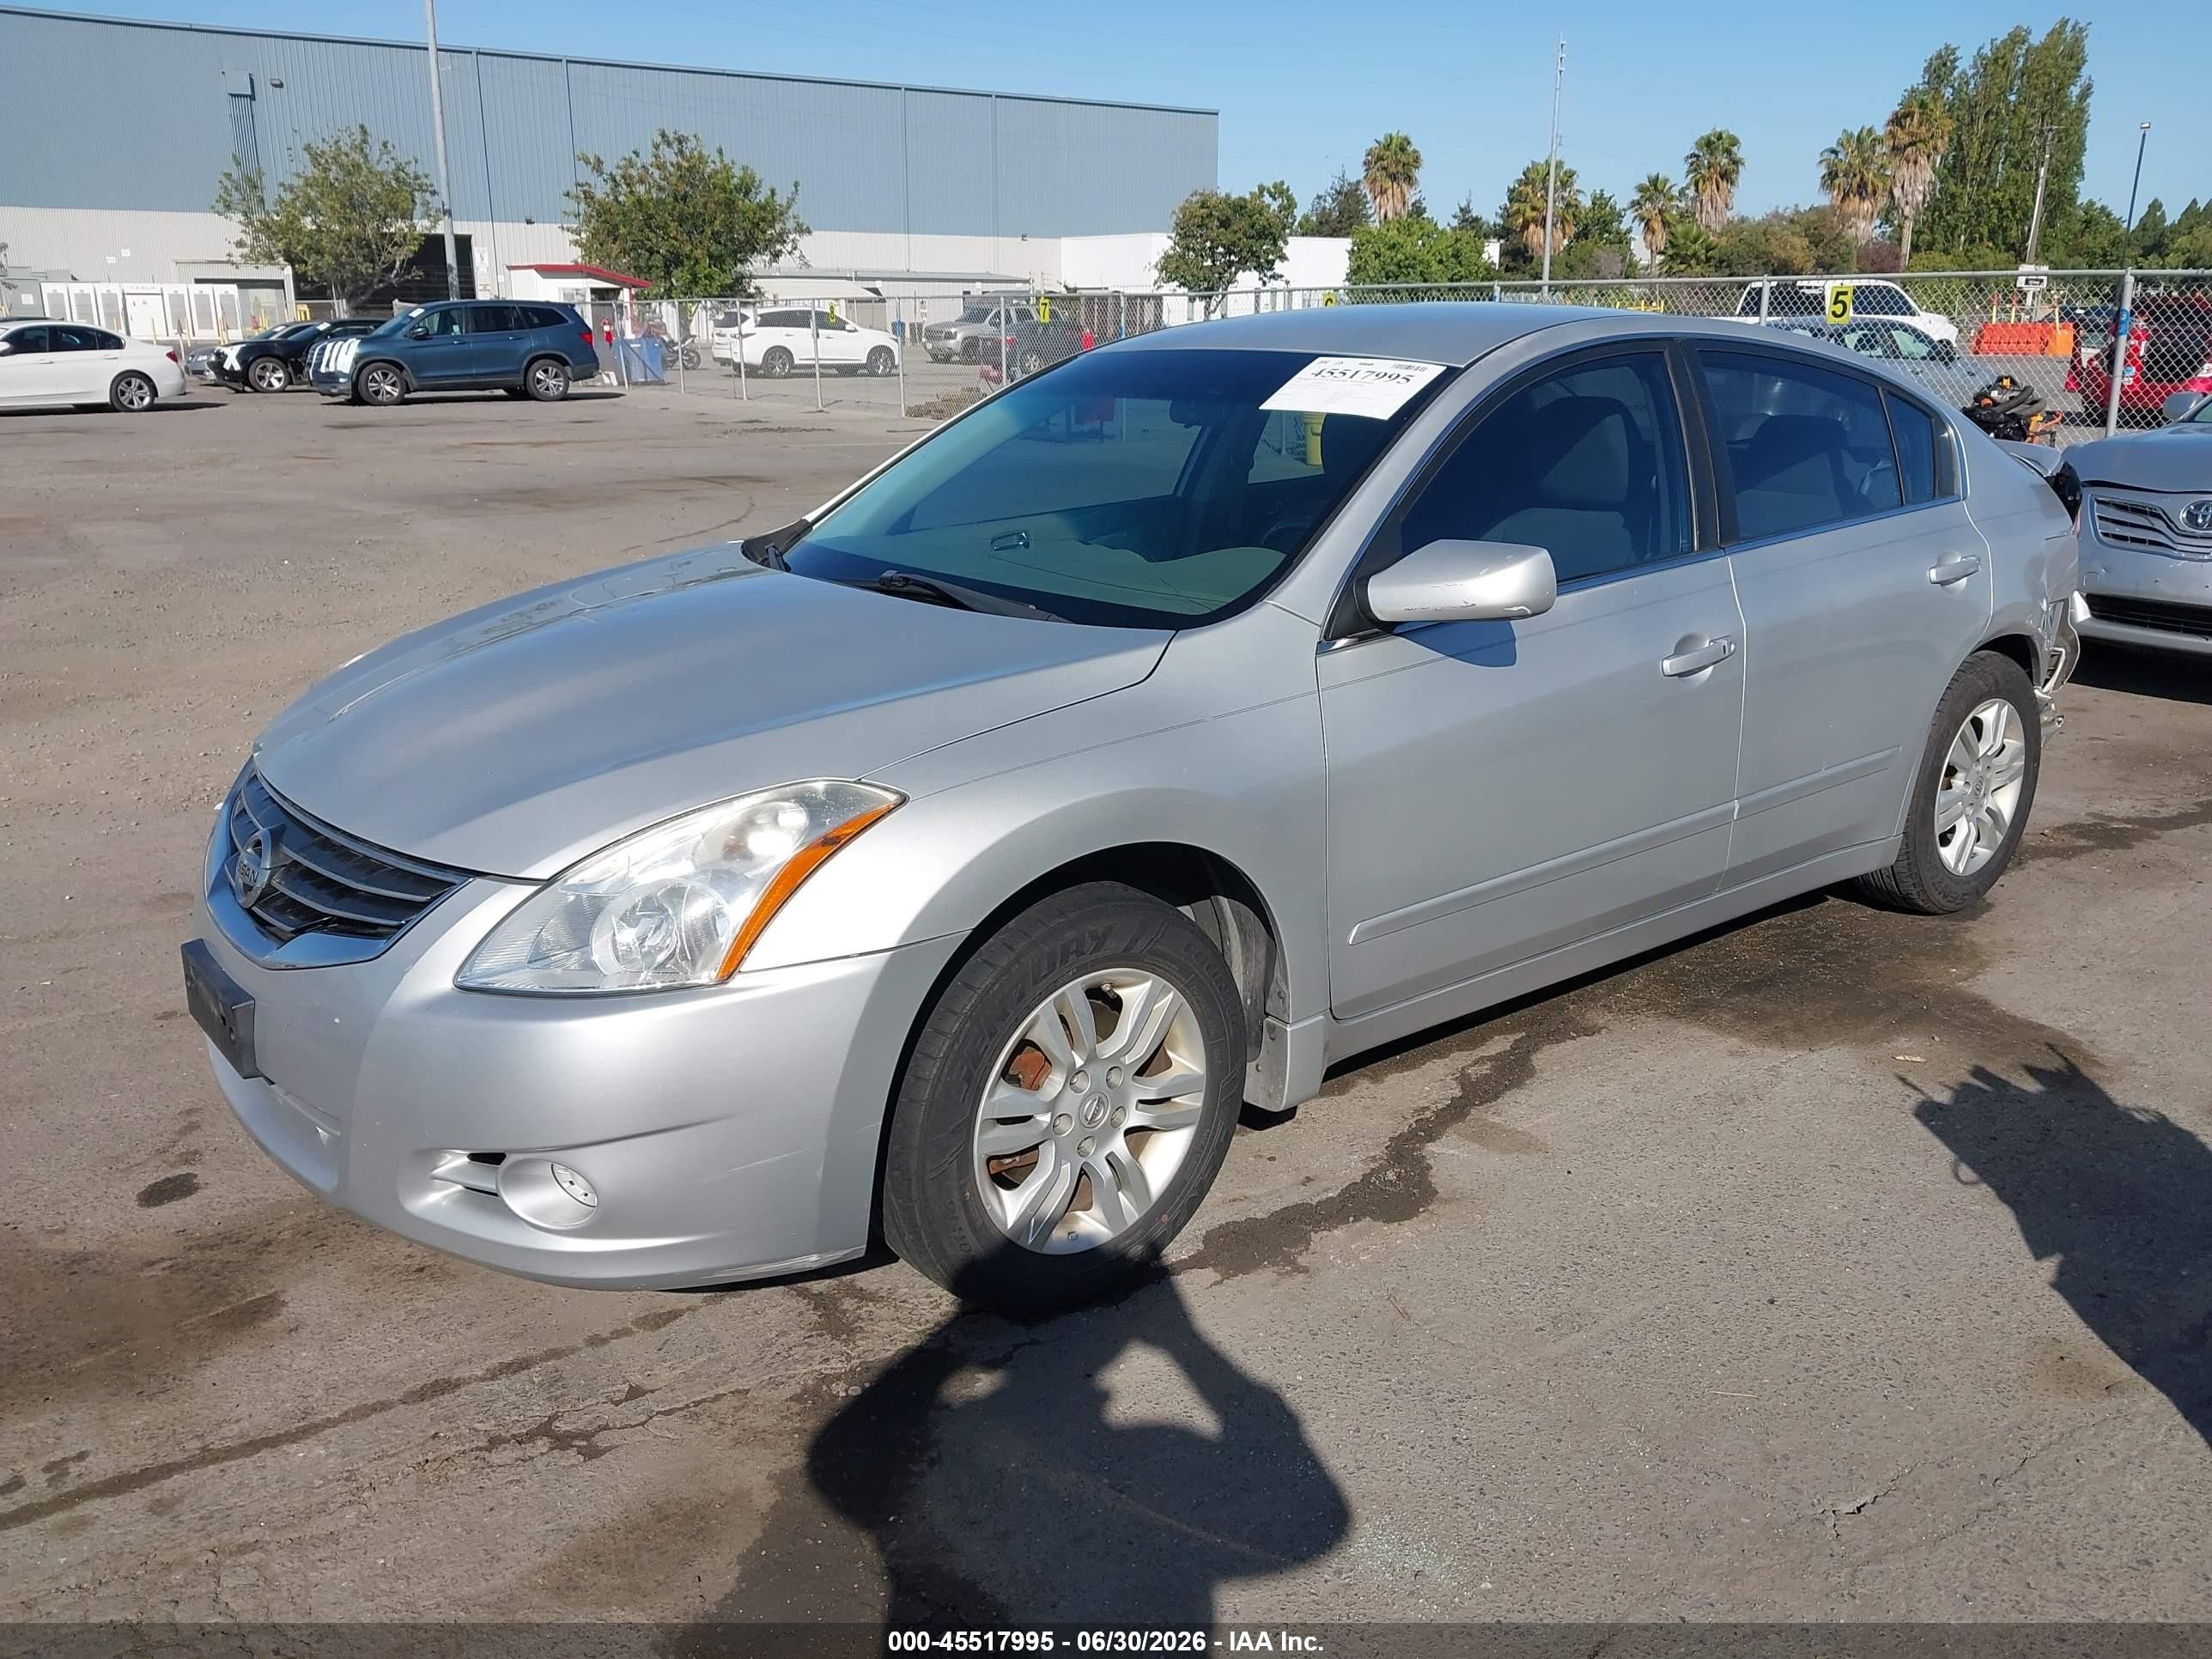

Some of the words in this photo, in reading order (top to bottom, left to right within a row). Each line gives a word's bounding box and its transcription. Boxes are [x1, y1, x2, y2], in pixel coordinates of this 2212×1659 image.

[830, 305, 835, 319] 8
[1041, 302, 1048, 319] 7
[1831, 290, 1849, 319] 5
[1311, 368, 1415, 385] 45517995
